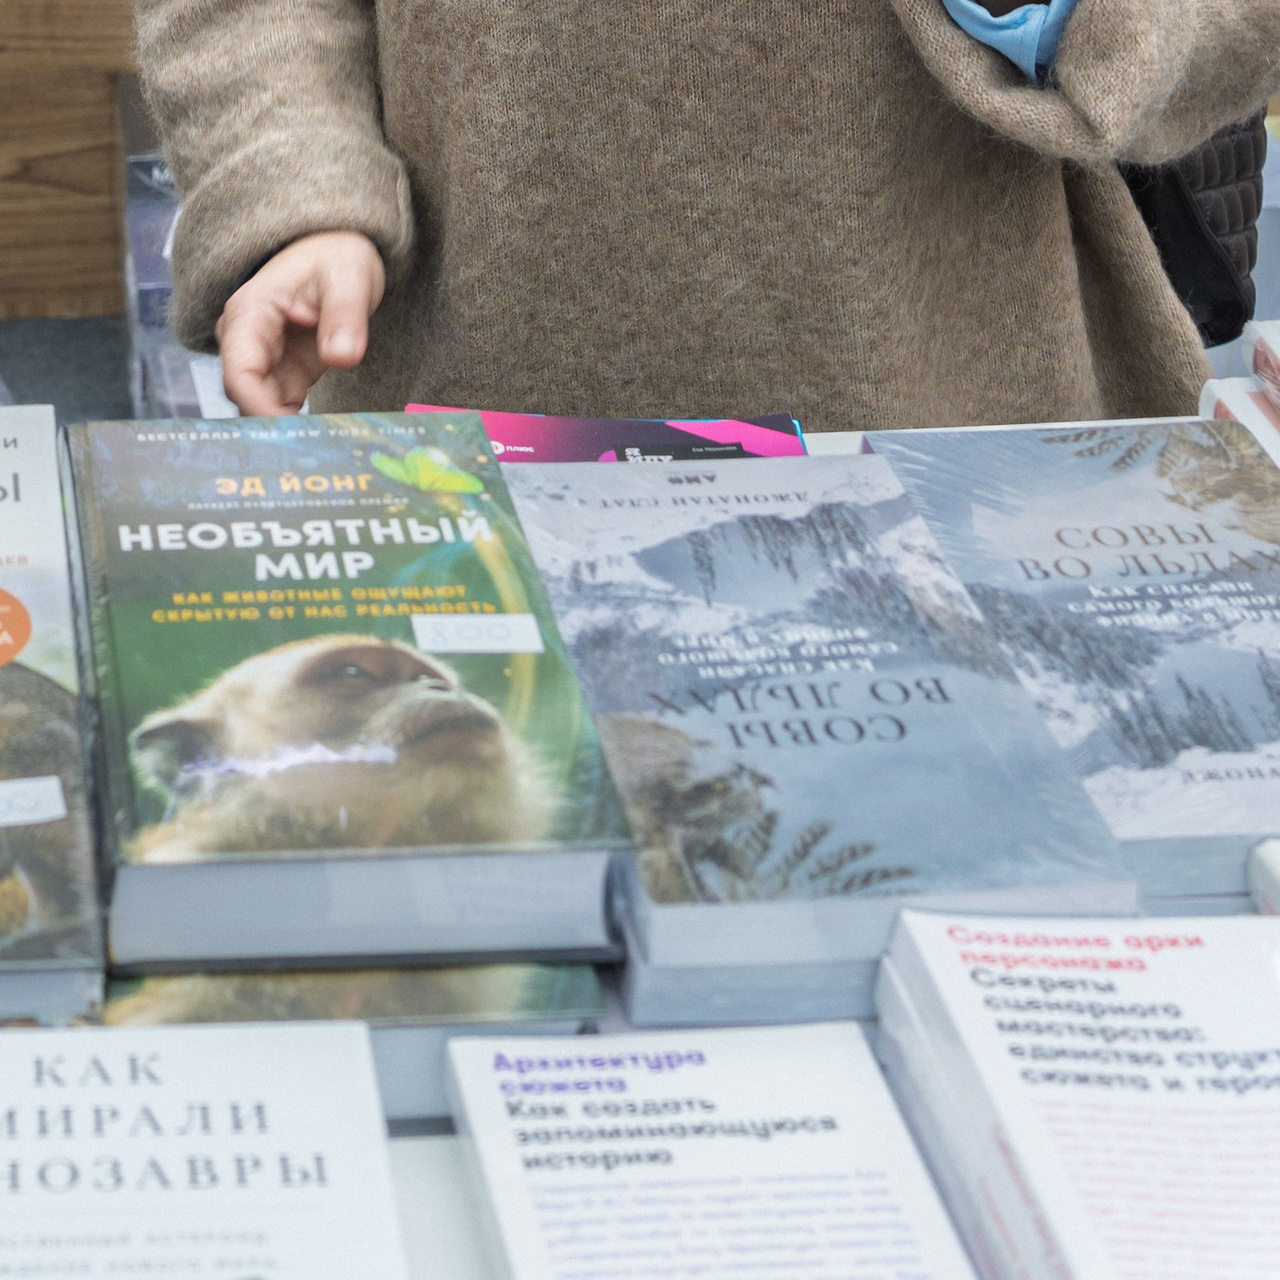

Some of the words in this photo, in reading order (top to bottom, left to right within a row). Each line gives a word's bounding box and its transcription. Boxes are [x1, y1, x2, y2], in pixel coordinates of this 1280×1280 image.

[215, 476, 267, 497] ЭД
[279, 471, 374, 493] ЙОНГ
[119, 509, 494, 552] НЕОБЪЯТНЫЙ
[1054, 523, 1217, 550] СОВЫ
[254, 551, 376, 582] МИР
[1018, 555, 1092, 581] ВО
[172, 591, 213, 607] КАК
[223, 587, 342, 605] ЖИВОТНЫЕ
[351, 585, 467, 602] ОЩУЩАЮТ
[151, 606, 261, 624] СКРЫТУЮ
[268, 605, 296, 621] ОТ
[304, 603, 349, 620] НАС
[356, 600, 497, 617] РЕАЛЬНОСТЬ
[648, 680, 842, 716] ЛЬДАХ
[869, 677, 953, 707] ВО
[727, 712, 908, 748] СОВЫ
[945, 923, 1111, 949] Создание
[1123, 934, 1205, 953] арки
[958, 951, 1148, 971] персонажа
[970, 966, 1116, 994] Секреты
[983, 995, 1182, 1019] сценарного
[995, 1019, 1207, 1044] мастерства:
[492, 1048, 707, 1074] Архитектура
[1007, 1043, 1166, 1069] единство
[32, 1052, 165, 1089] КАК
[1019, 1069, 1151, 1092] сюжета
[1161, 1077, 1186, 1092] и
[498, 1075, 628, 1096] сюжета
[506, 1097, 567, 1120] Как
[581, 1096, 716, 1117] создать
[515, 1113, 838, 1145] запоминающуюся
[522, 1147, 674, 1171] историю
